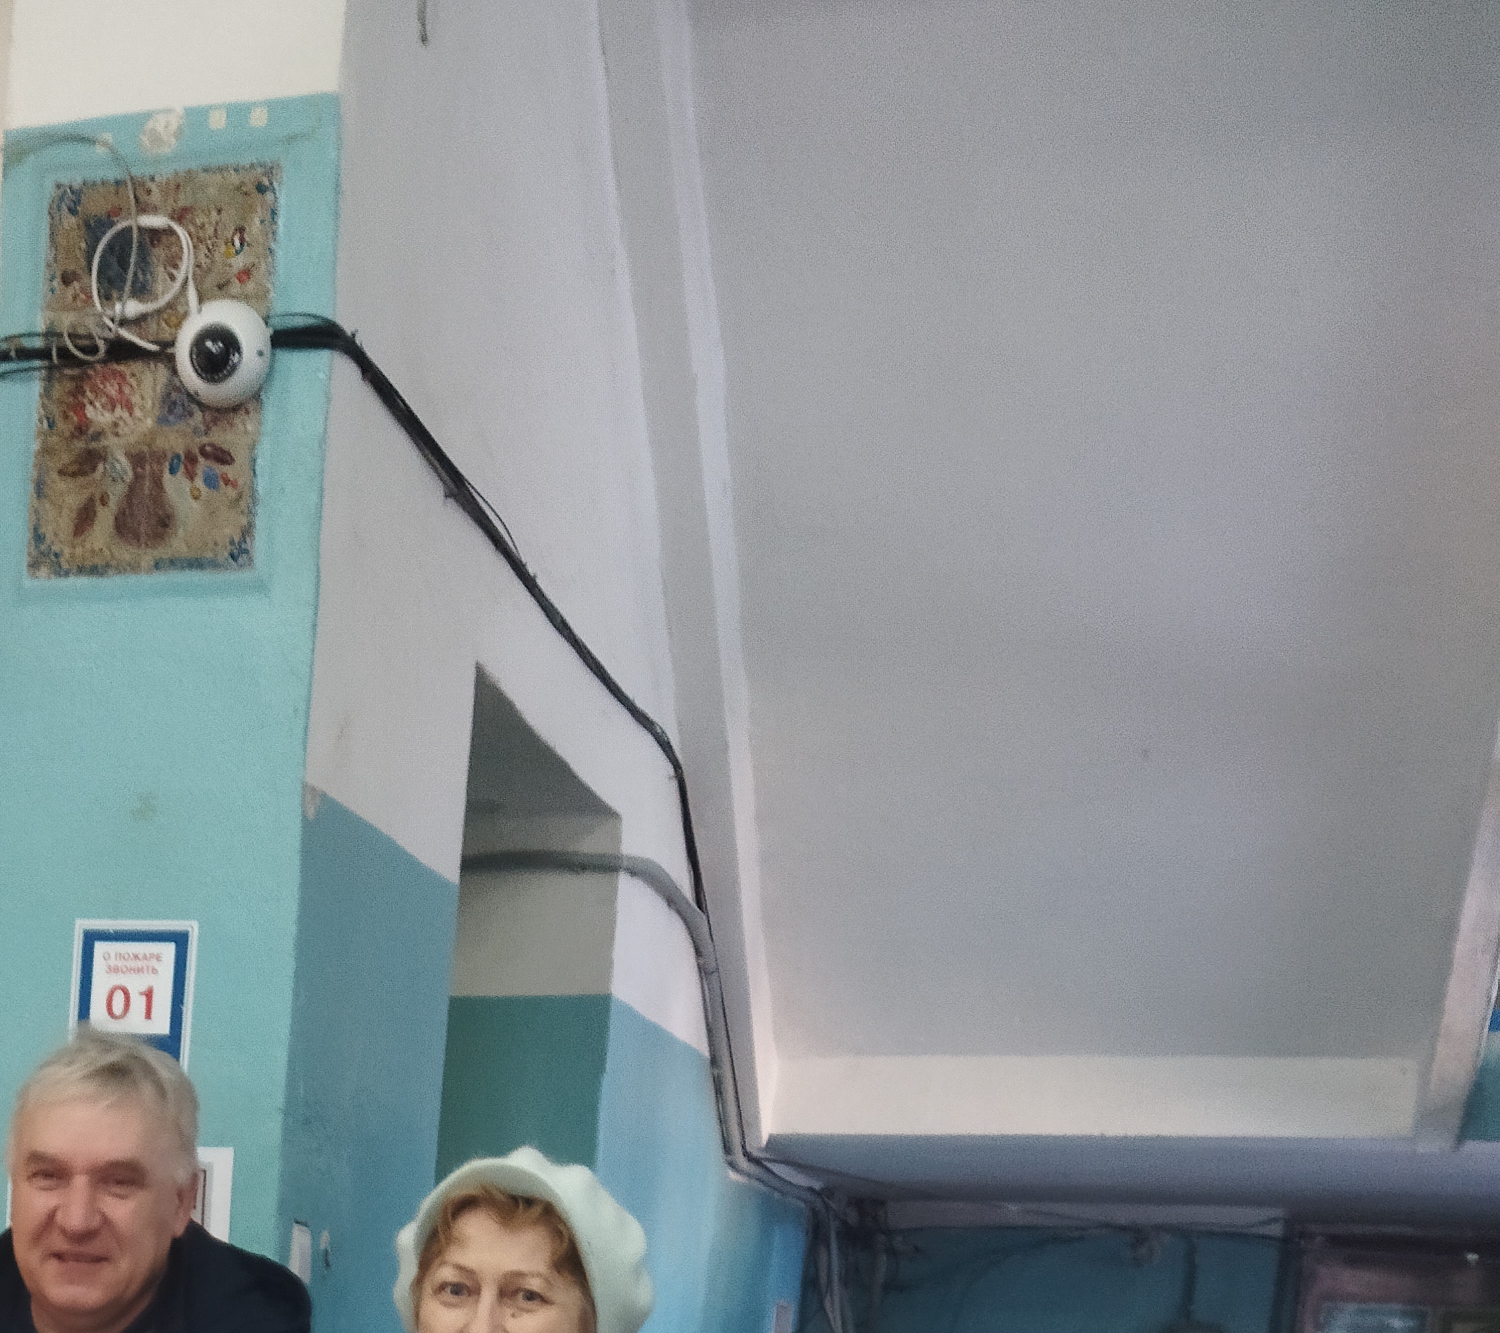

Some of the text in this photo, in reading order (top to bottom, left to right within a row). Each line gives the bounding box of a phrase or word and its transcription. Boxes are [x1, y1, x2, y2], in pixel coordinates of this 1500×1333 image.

[102, 952, 163, 962] О ПОЖАРЕ
[105, 964, 159, 975] ЗВОНИТЬ
[106, 984, 154, 1020] 01
